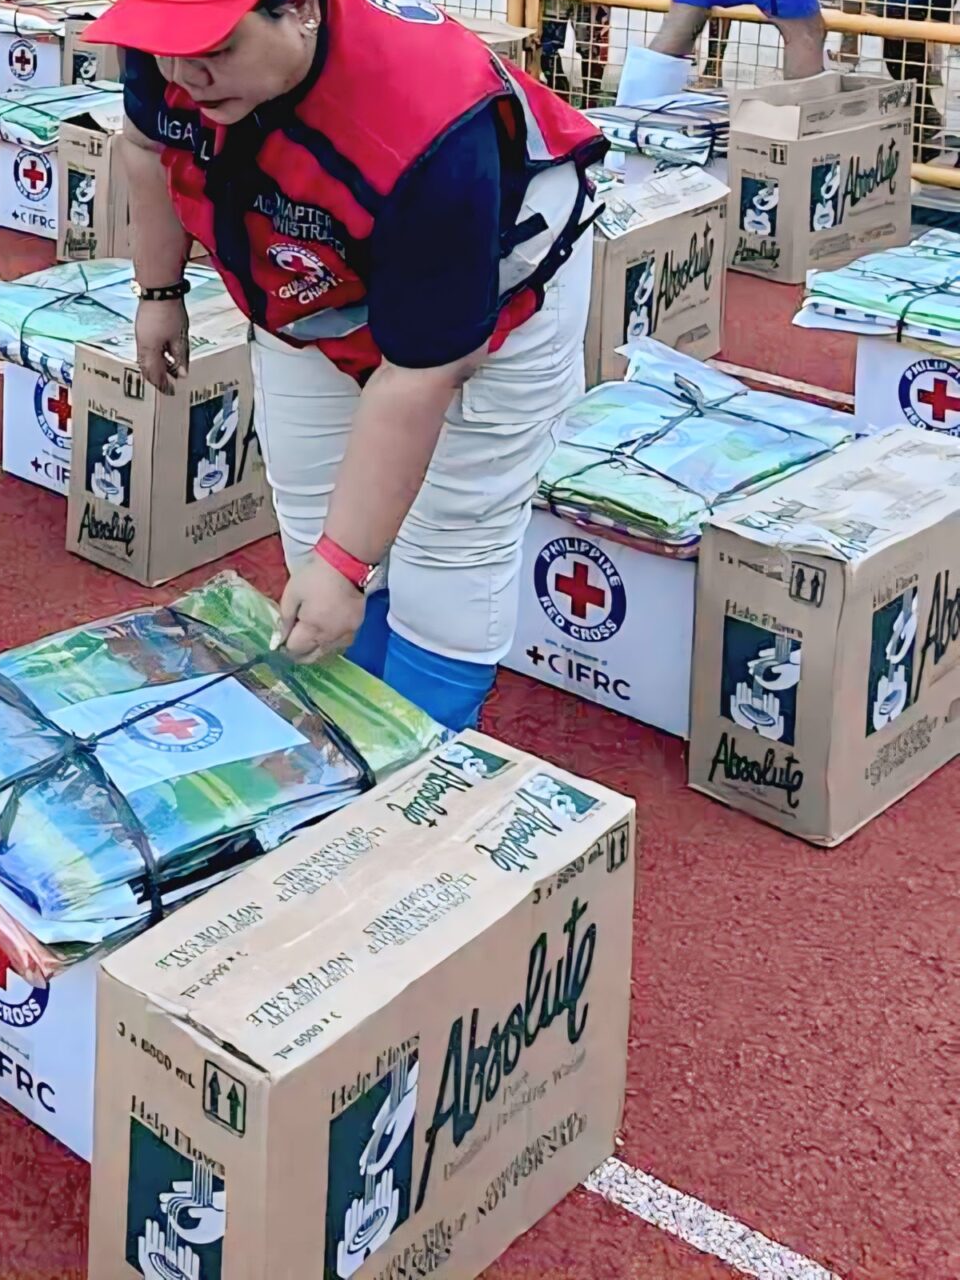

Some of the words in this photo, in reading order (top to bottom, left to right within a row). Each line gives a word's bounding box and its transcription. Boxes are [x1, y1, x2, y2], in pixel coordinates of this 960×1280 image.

[78, 503, 135, 557] Absolute
[540, 538, 622, 587] PHILIPPINE
[540, 595, 566, 628] RED
[570, 619, 617, 641] CROSS
[708, 732, 803, 808] Absolute
[474, 788, 563, 872] Absolute
[246, 991, 285, 1027] SALE
[415, 896, 597, 1213] Absolute
[131, 1095, 169, 1141] Help
